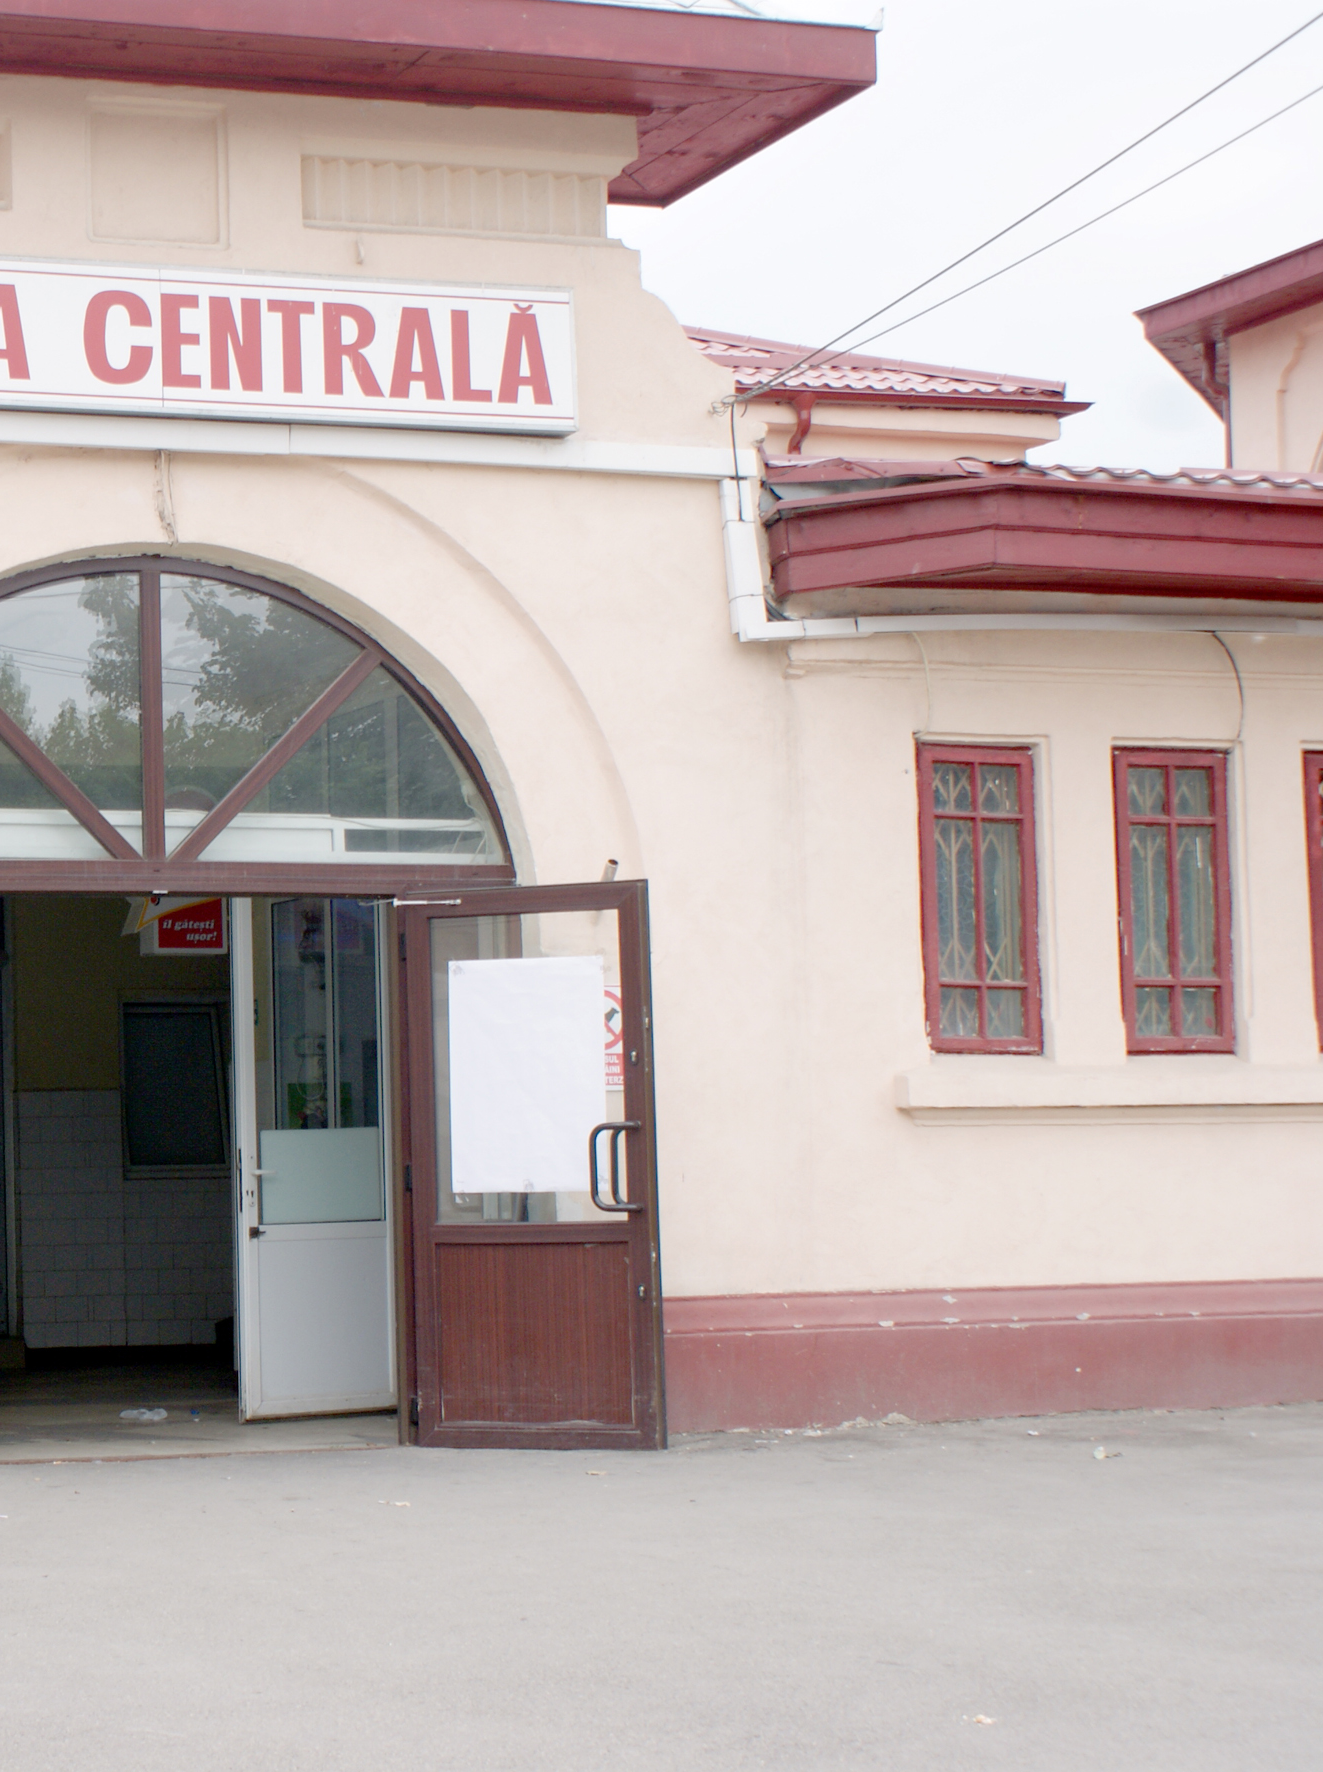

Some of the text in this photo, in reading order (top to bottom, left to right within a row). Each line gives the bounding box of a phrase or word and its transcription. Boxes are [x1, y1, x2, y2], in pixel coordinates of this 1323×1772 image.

[83, 290, 553, 405] CENTRALĂ
[604, 1054, 619, 1063] SUL
[605, 1075, 624, 1084] TERZ
